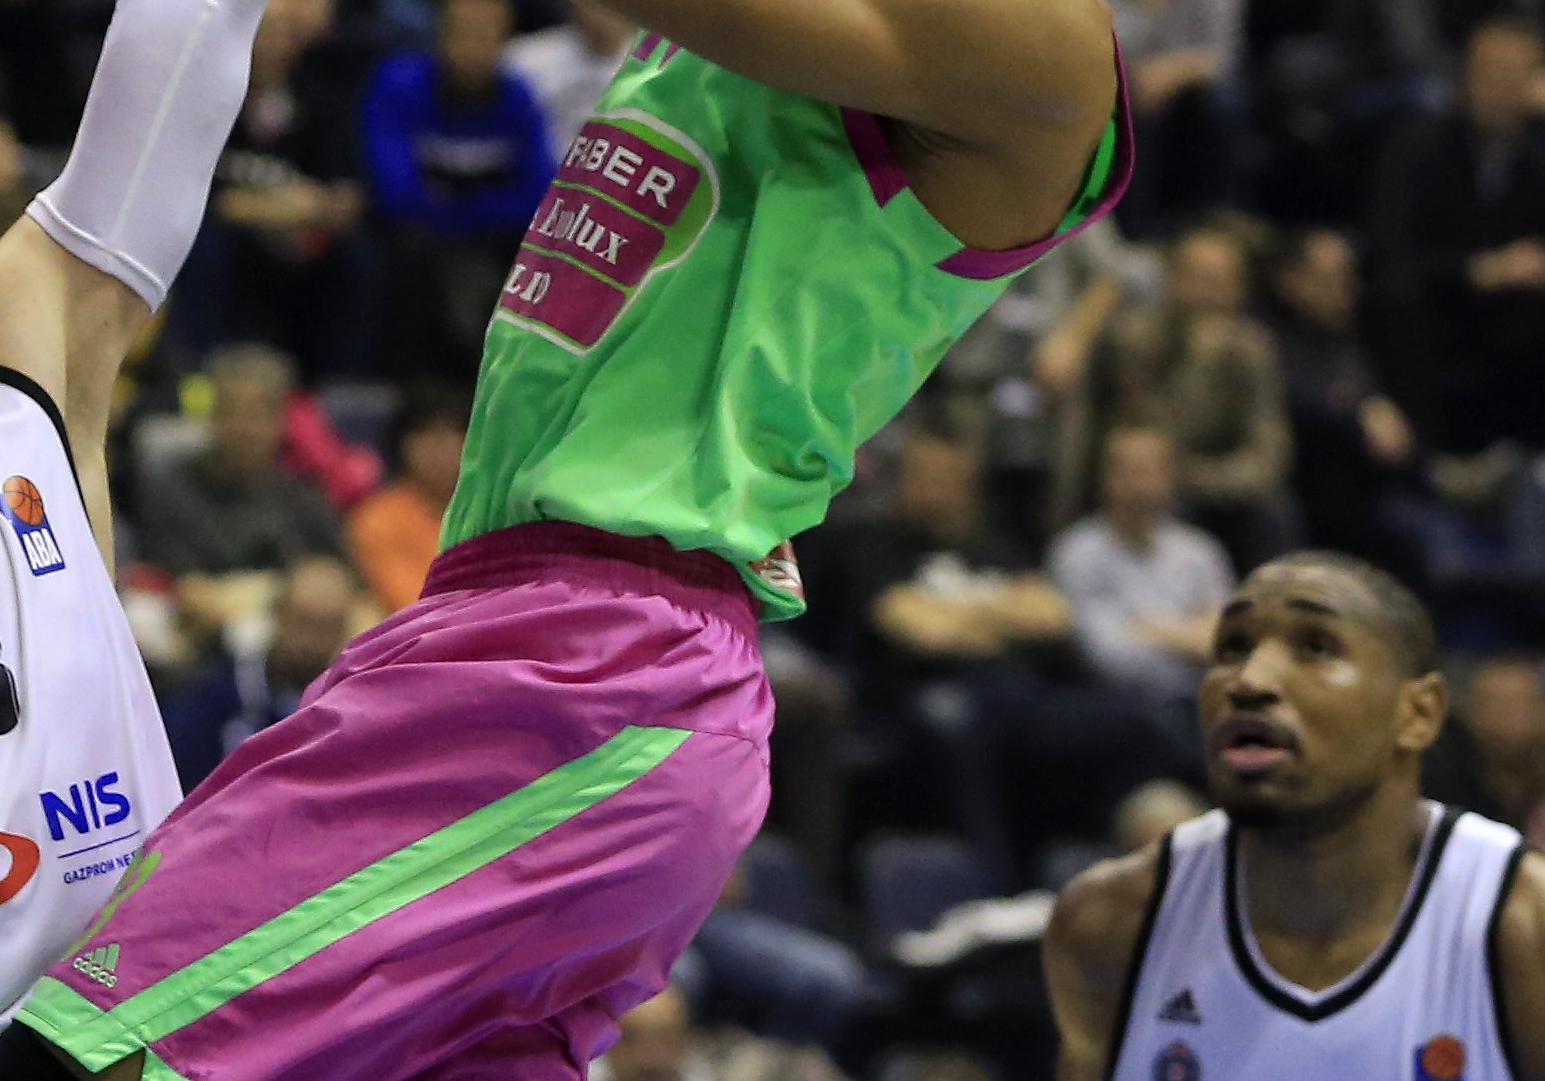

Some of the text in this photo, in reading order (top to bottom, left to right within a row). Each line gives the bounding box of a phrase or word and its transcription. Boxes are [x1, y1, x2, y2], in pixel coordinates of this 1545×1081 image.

[22, 527, 63, 571] ABA
[39, 771, 132, 841] NIS
[63, 859, 116, 884] GAZPROM
